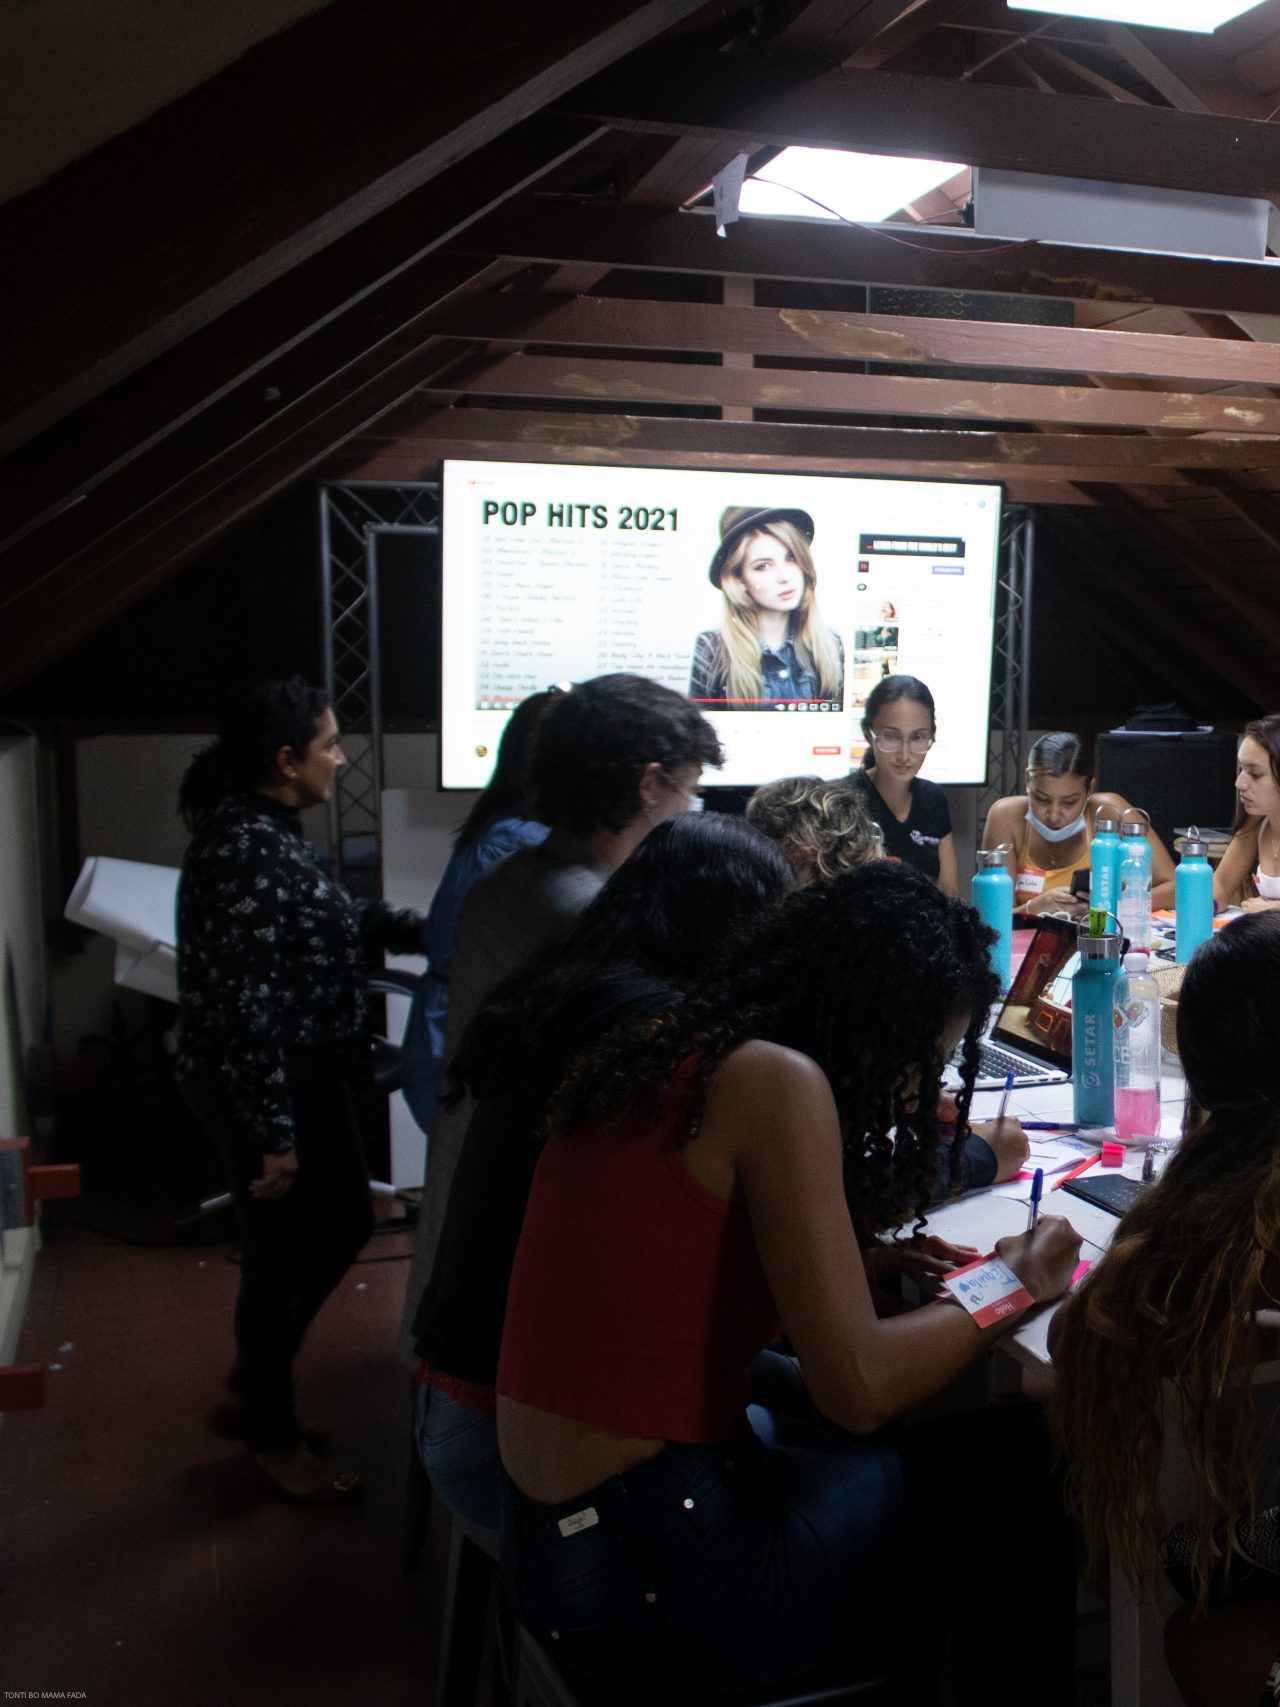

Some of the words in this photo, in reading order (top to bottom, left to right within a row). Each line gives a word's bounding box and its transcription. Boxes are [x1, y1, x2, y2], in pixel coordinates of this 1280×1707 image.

[483, 500, 536, 526] POP
[547, 503, 608, 529] HITS
[619, 506, 678, 531] 2021
[1084, 1014, 1097, 1066] SETAR
[995, 1303, 1014, 1315] Hello
